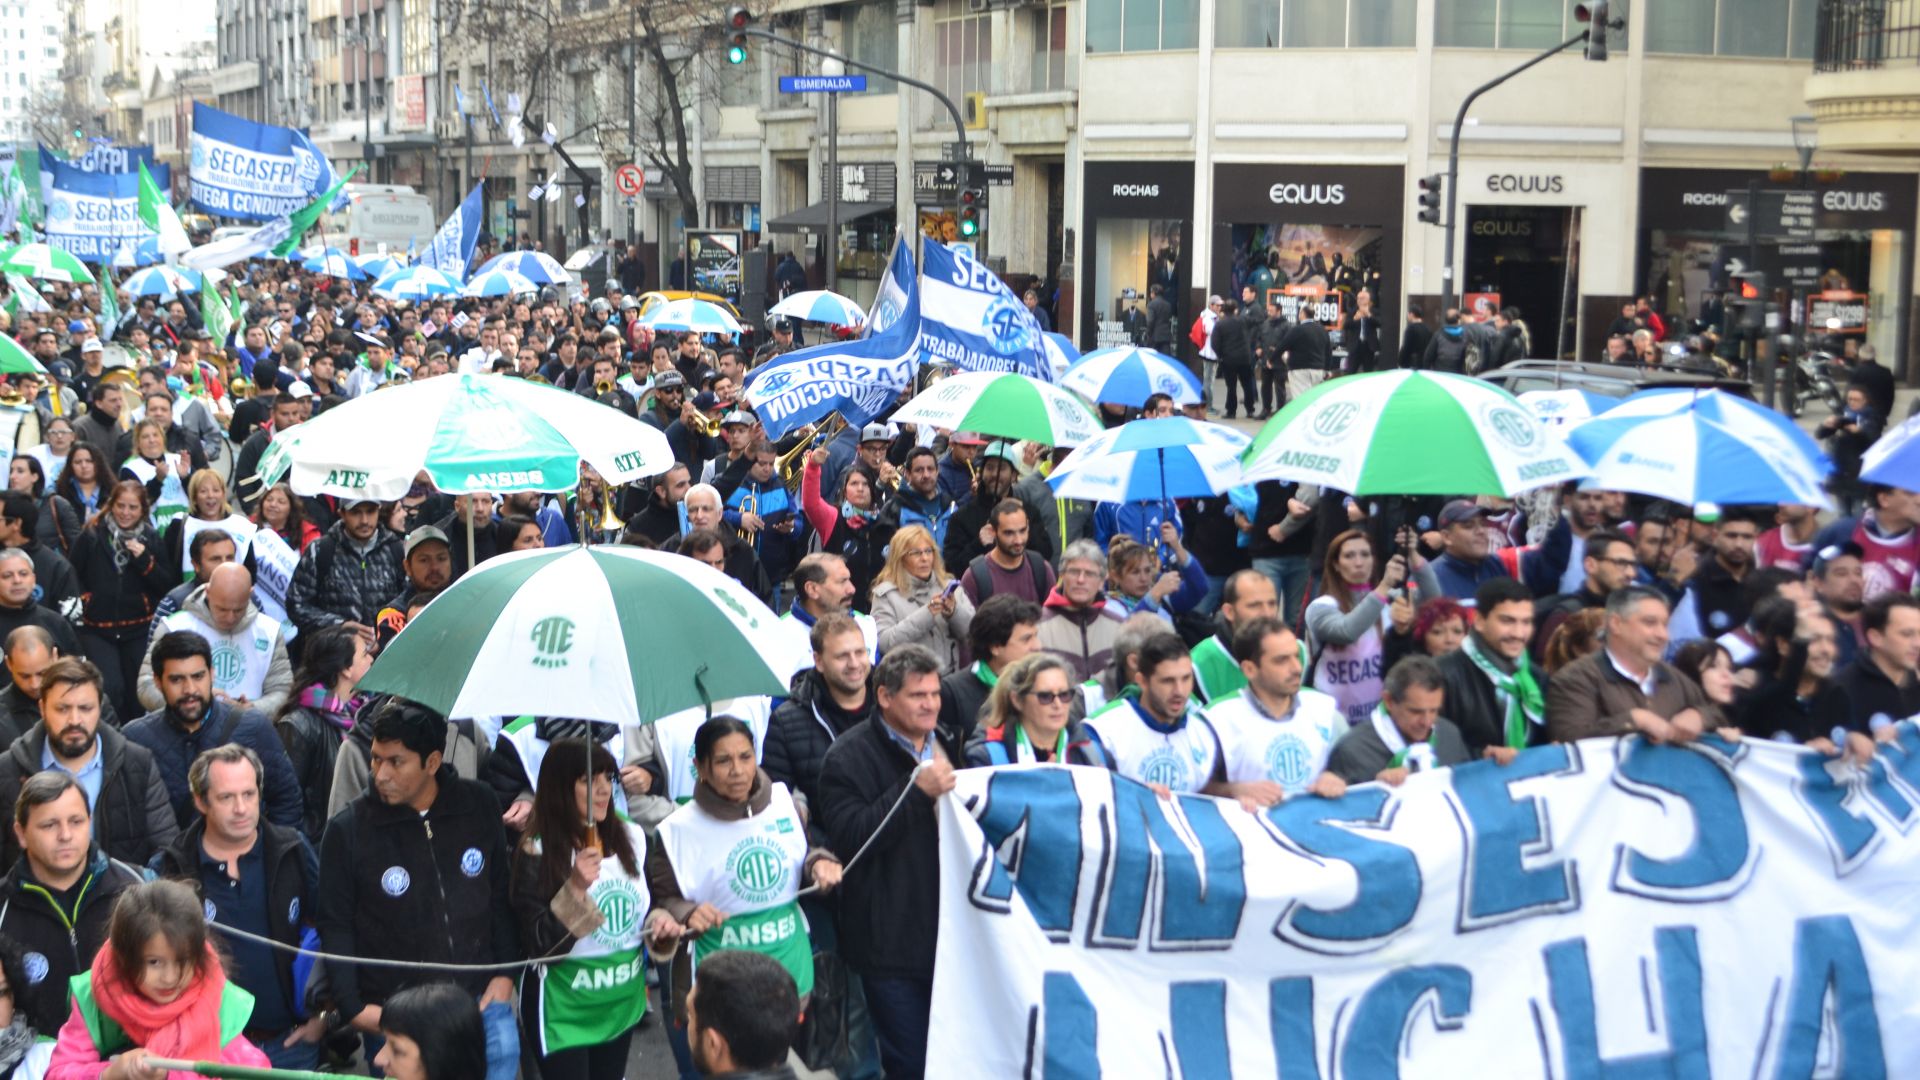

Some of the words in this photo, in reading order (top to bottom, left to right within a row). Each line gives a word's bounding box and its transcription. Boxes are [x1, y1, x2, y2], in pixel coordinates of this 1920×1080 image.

[794, 78, 852, 90] ESMERALDA
[210, 147, 297, 183] SECASFPI
[1113, 184, 1159, 197] ROCHAS
[1269, 183, 1344, 205] EQUUS
[1486, 174, 1563, 194] EQUUS
[1823, 191, 1883, 211] EQUUS
[1473, 220, 1532, 236] EQUUS
[1316, 402, 1358, 434] ATE
[1490, 408, 1534, 447] ATE
[614, 450, 646, 472] ATE
[1275, 450, 1341, 474] ANSES
[1517, 458, 1571, 481] ANSES
[323, 469, 369, 488] ATE
[464, 470, 544, 488] ANSES
[531, 616, 576, 654] ATE
[212, 651, 238, 679] ATE
[968, 734, 1762, 957] ANSES
[741, 852, 779, 889] ATE
[720, 913, 796, 948] ANSES
